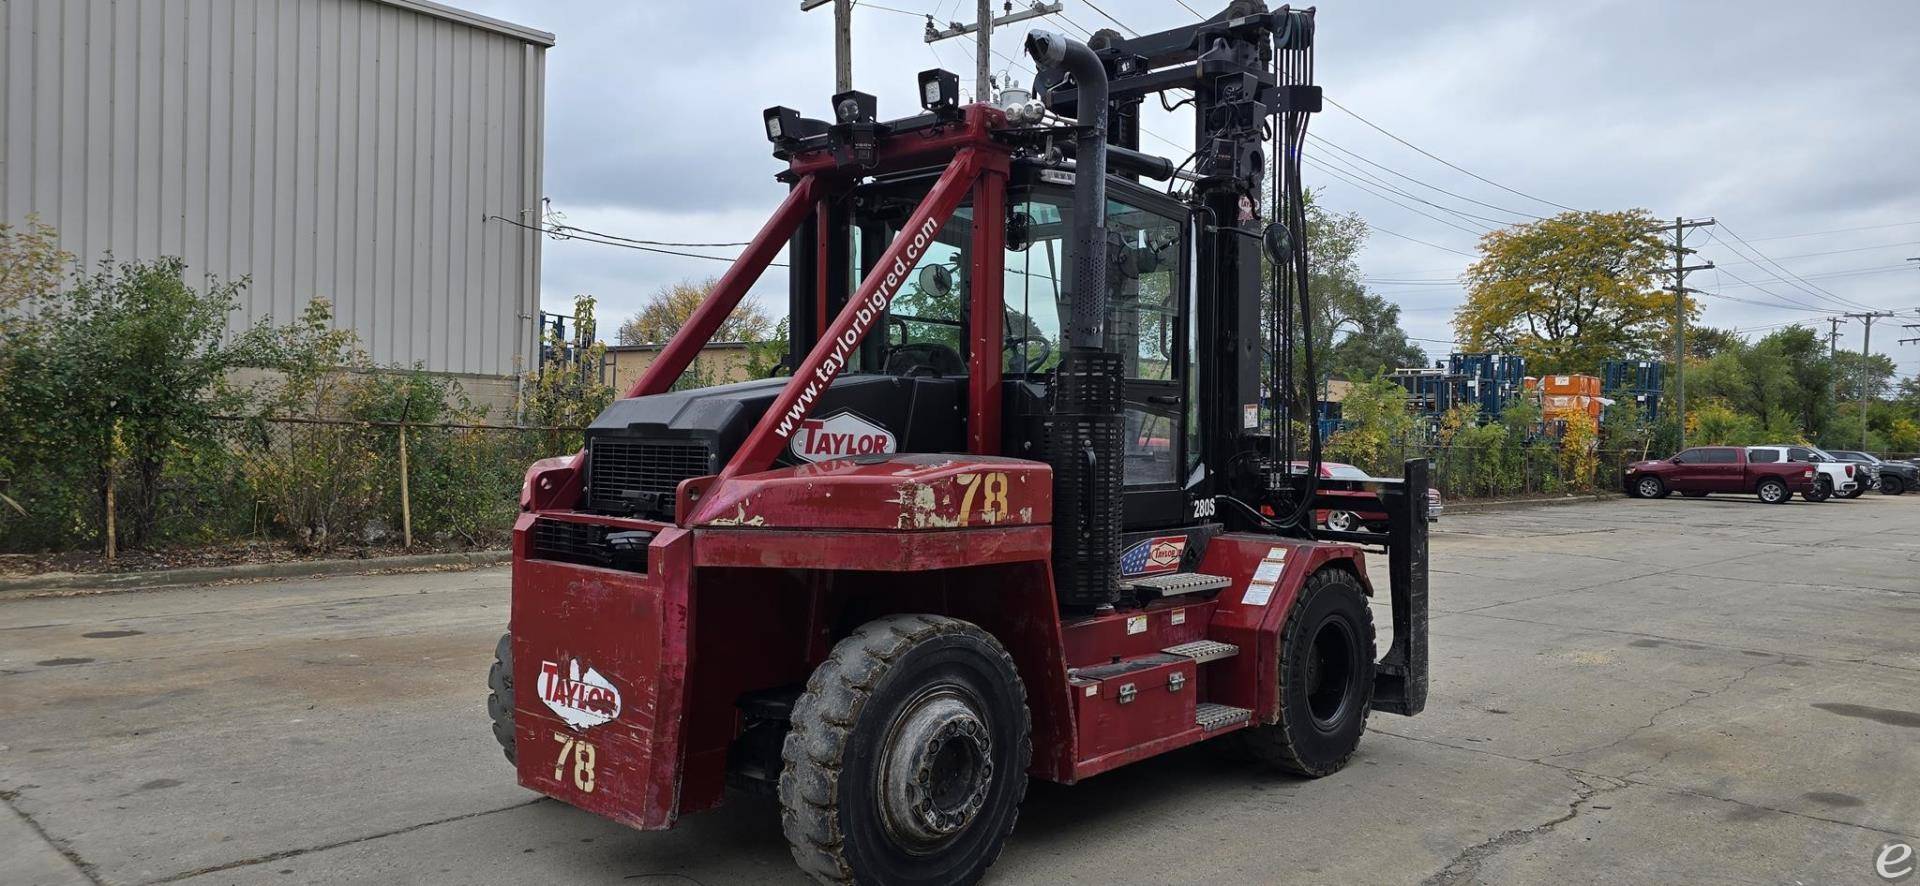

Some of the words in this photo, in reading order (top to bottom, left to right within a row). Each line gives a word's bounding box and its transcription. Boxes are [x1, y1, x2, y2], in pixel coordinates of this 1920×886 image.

[775, 216, 938, 437] www.taylorbigred.com
[802, 421, 888, 455] TAYLOR
[957, 472, 1008, 526] 78
[1194, 498, 1215, 518] 280S
[543, 664, 616, 716] TAYLOR
[554, 732, 596, 793] 78
